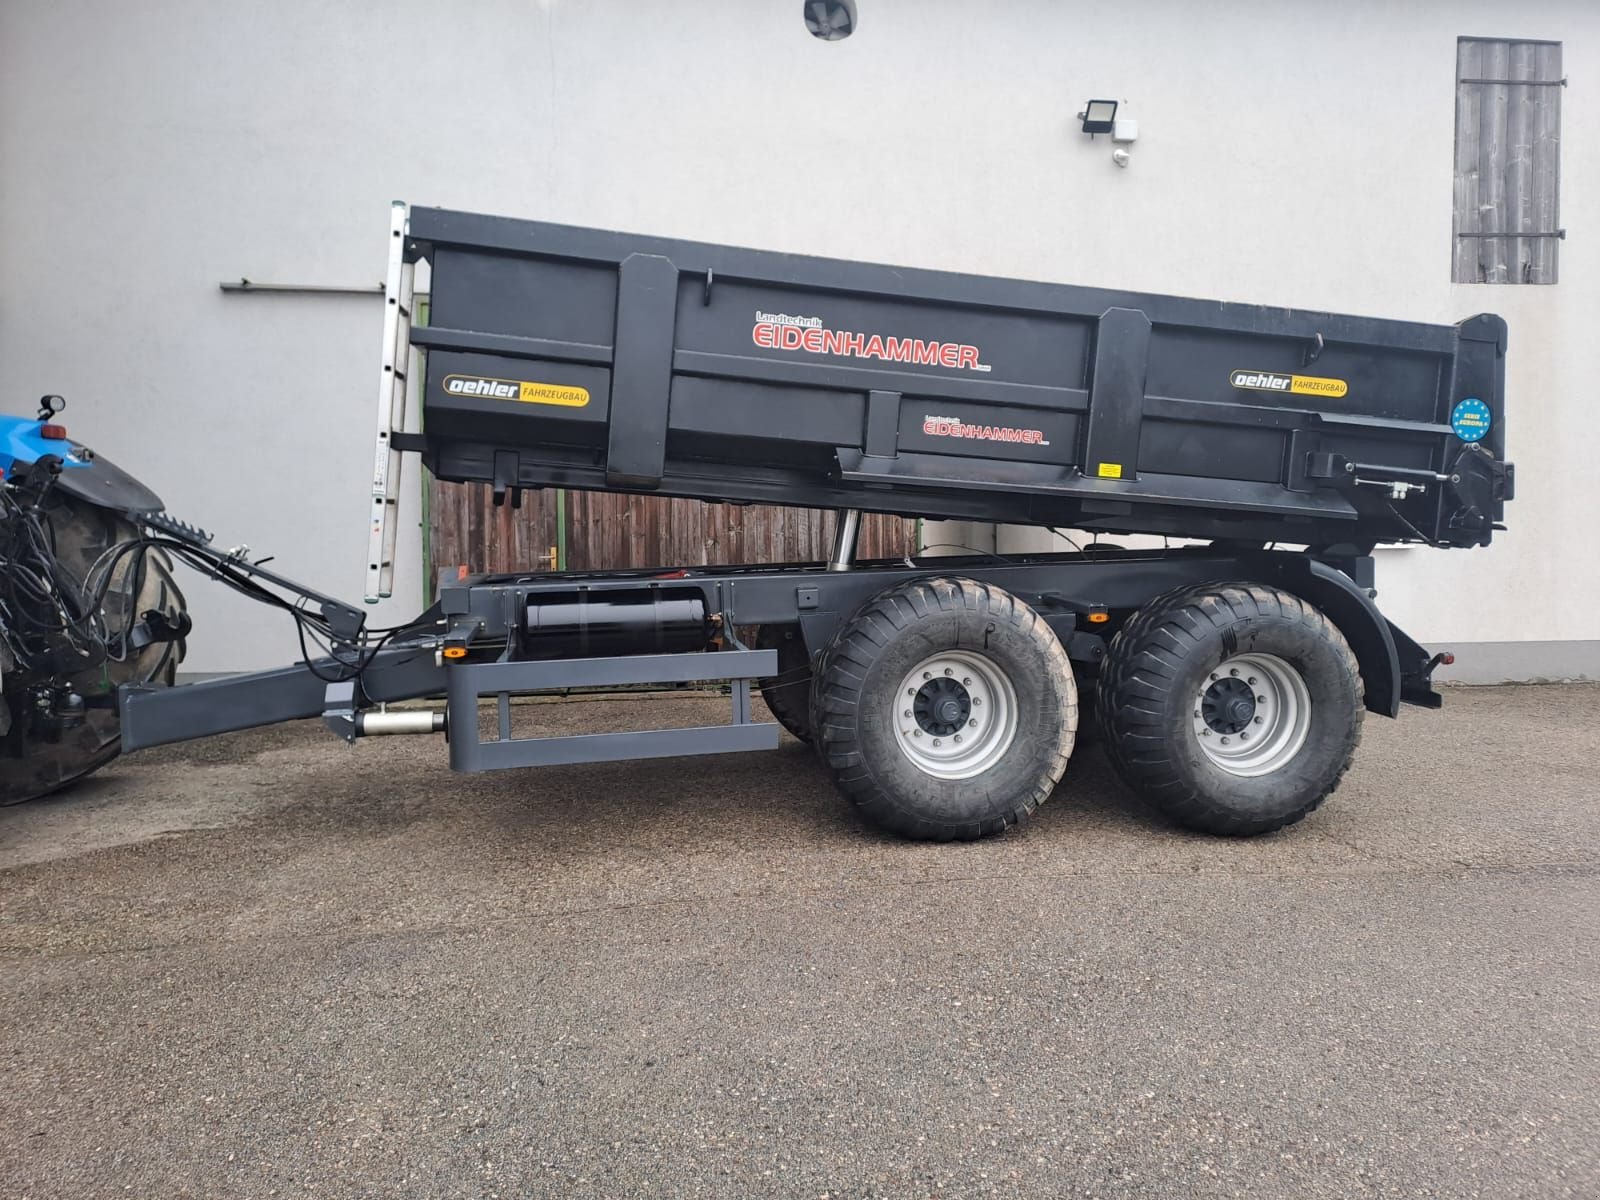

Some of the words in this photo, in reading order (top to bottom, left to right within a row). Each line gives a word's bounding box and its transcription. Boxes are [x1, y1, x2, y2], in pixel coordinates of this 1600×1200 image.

[756, 311, 823, 329] Landtechnik
[752, 322, 981, 370] EIDENHAMMER
[449, 379, 519, 398] oehler
[522, 387, 587, 402] FAHRZEUGBAU
[1234, 374, 1291, 390] oehler
[1294, 381, 1346, 393] FAHRZEUGBAU
[923, 421, 1044, 444] EIDENHAMMER
